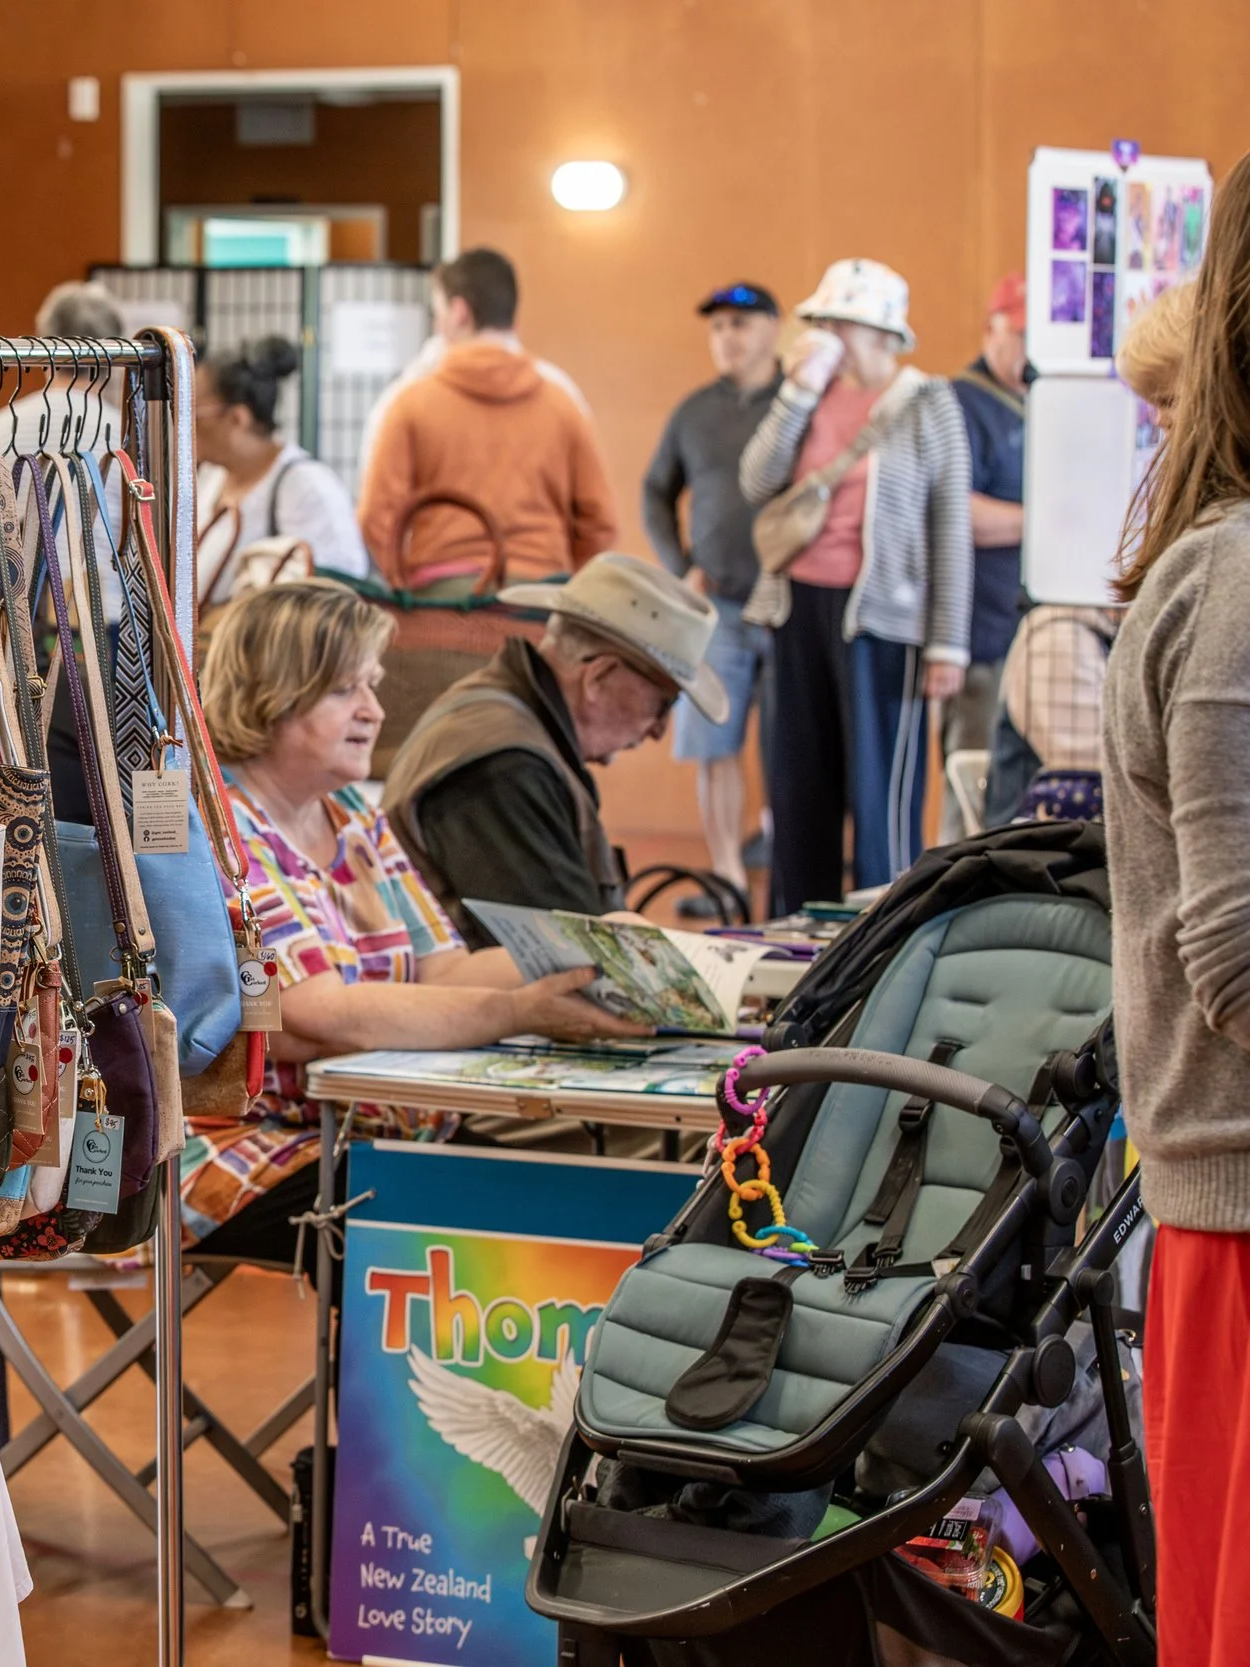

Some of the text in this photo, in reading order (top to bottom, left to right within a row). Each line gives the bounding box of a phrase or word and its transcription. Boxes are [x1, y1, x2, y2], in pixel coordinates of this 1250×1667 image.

[60, 1034, 76, 1044] $125
[76, 1165, 113, 1177] Thank You
[360, 1521, 432, 1555] A True
[360, 1561, 492, 1604] New Zealand
[357, 1604, 473, 1650] Love Story
